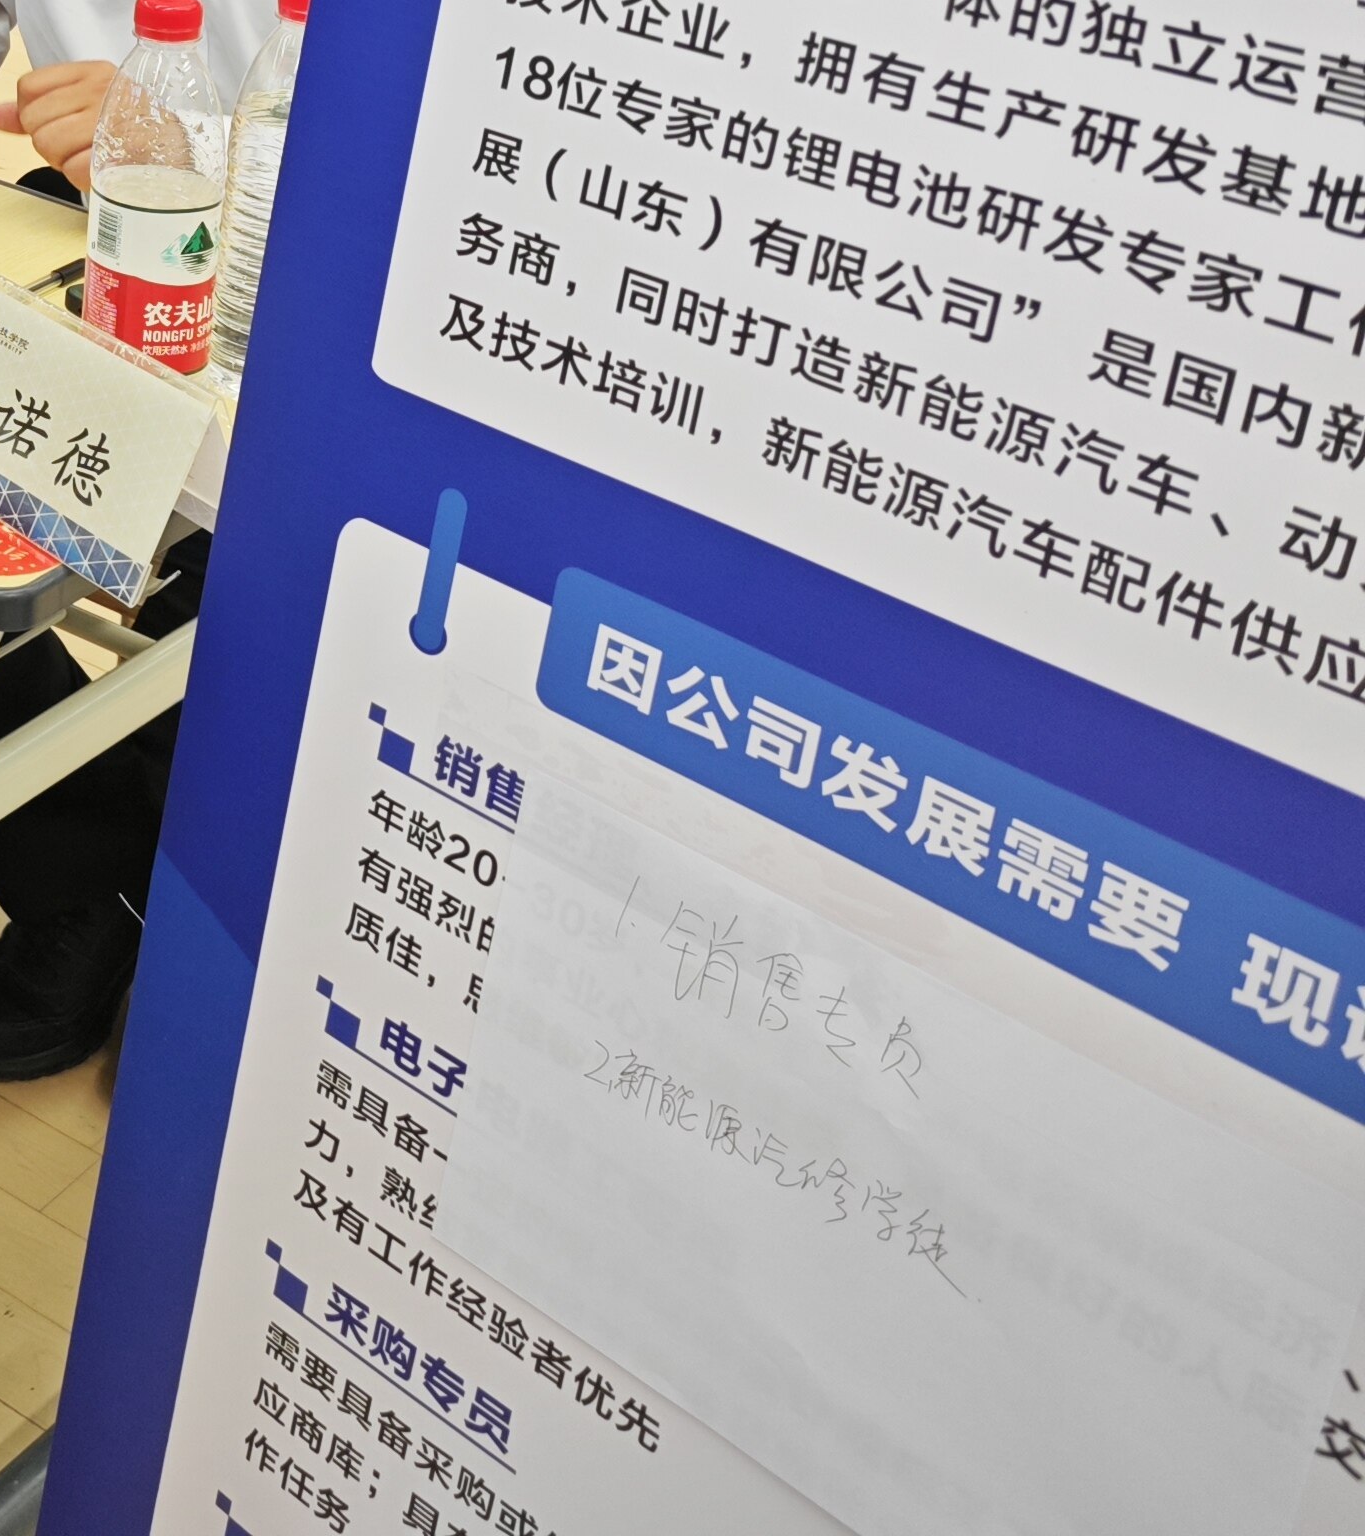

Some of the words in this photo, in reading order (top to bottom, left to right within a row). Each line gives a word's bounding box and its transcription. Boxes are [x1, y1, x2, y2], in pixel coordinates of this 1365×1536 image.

[492, 46, 1365, 357] 18位专家的锂电池研发专家工
[142, 328, 195, 343] NONGFU
[367, 790, 506, 888] 年龄20
[434, 734, 526, 824] 销售
[586, 623, 1190, 972] 因公司发展需要
[1232, 933, 1365, 1076] 现
[379, 1017, 468, 1098] 电子
[293, 1169, 661, 1454] 及有工作经验者优先
[324, 1282, 513, 1456] 采购专员
[244, 1427, 350, 1534] 作任务
[265, 1320, 556, 1536] 需要具备采购或
